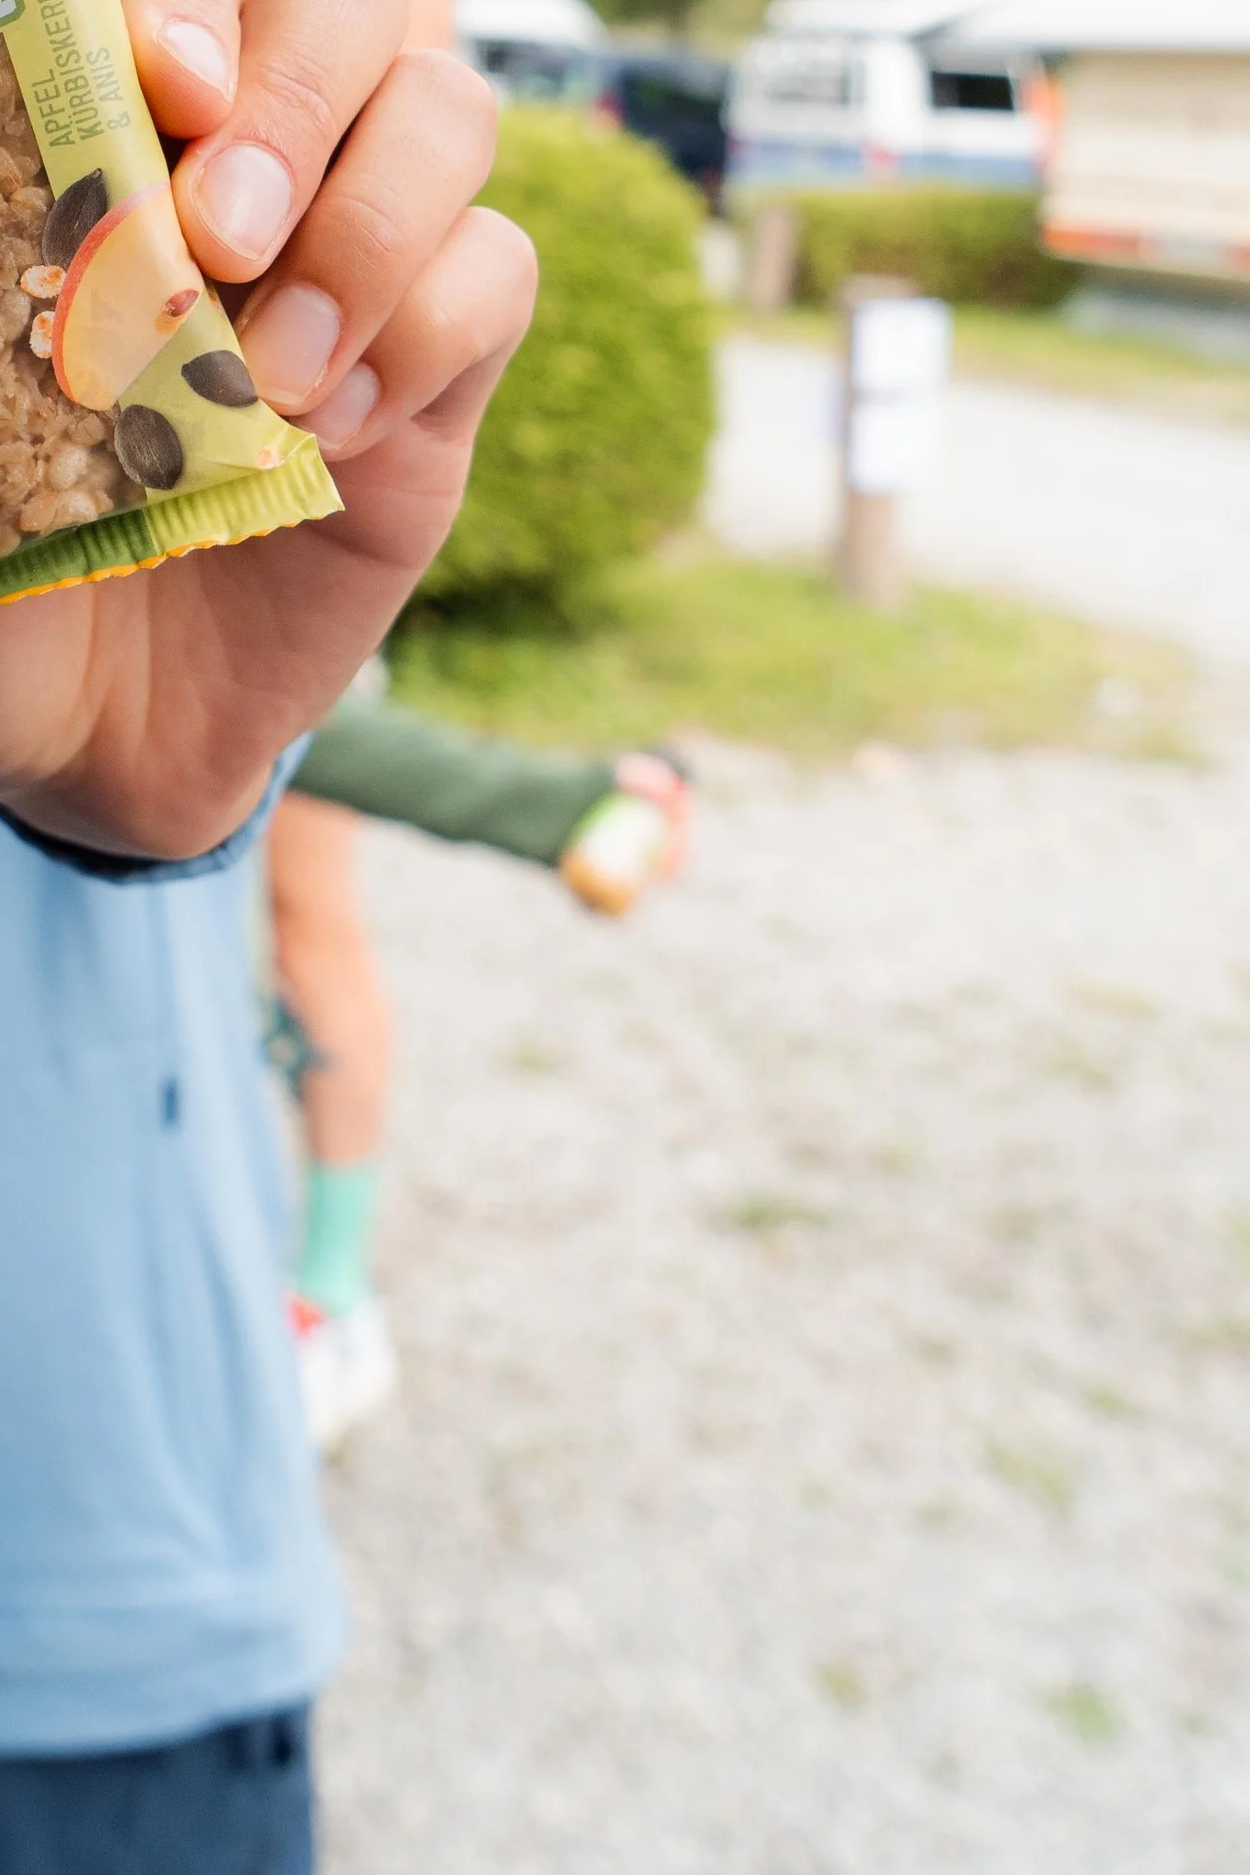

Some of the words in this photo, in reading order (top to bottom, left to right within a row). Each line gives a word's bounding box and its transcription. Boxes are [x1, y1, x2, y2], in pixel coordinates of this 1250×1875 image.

[85, 47, 124, 102] ANIS
[31, 68, 76, 148] APFEL
[106, 110, 131, 131] &
